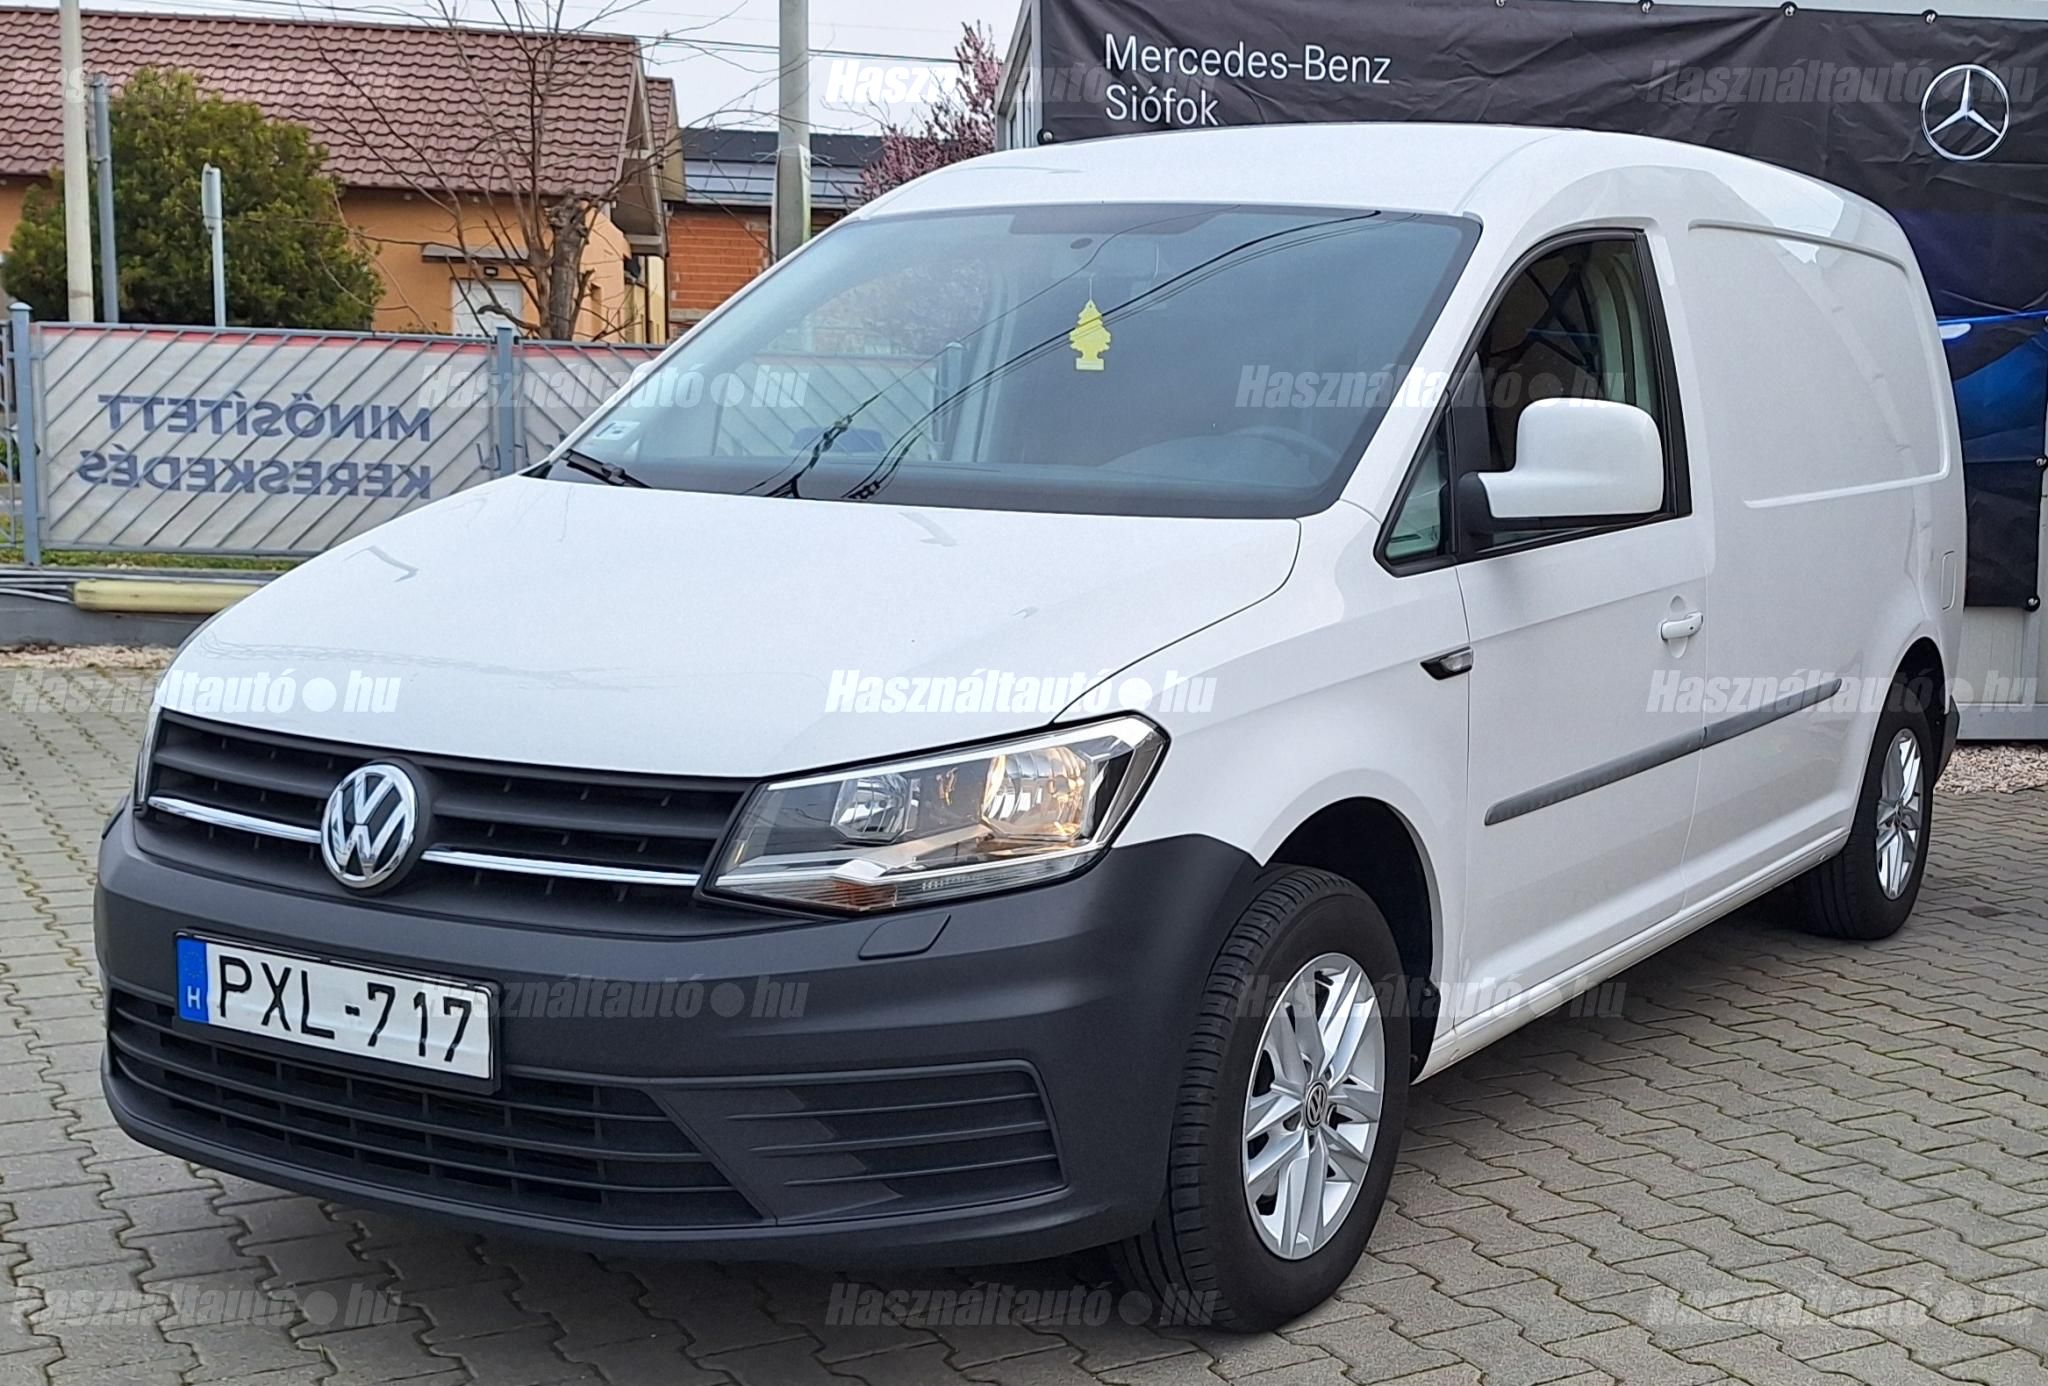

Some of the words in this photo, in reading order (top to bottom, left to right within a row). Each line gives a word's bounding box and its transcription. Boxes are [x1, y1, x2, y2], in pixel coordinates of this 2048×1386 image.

[1105, 33, 1391, 84] Mercedes-Benz
[1105, 84, 1219, 126] Siófok
[186, 985, 201, 1010] H
[218, 954, 472, 1063] PXL-717
